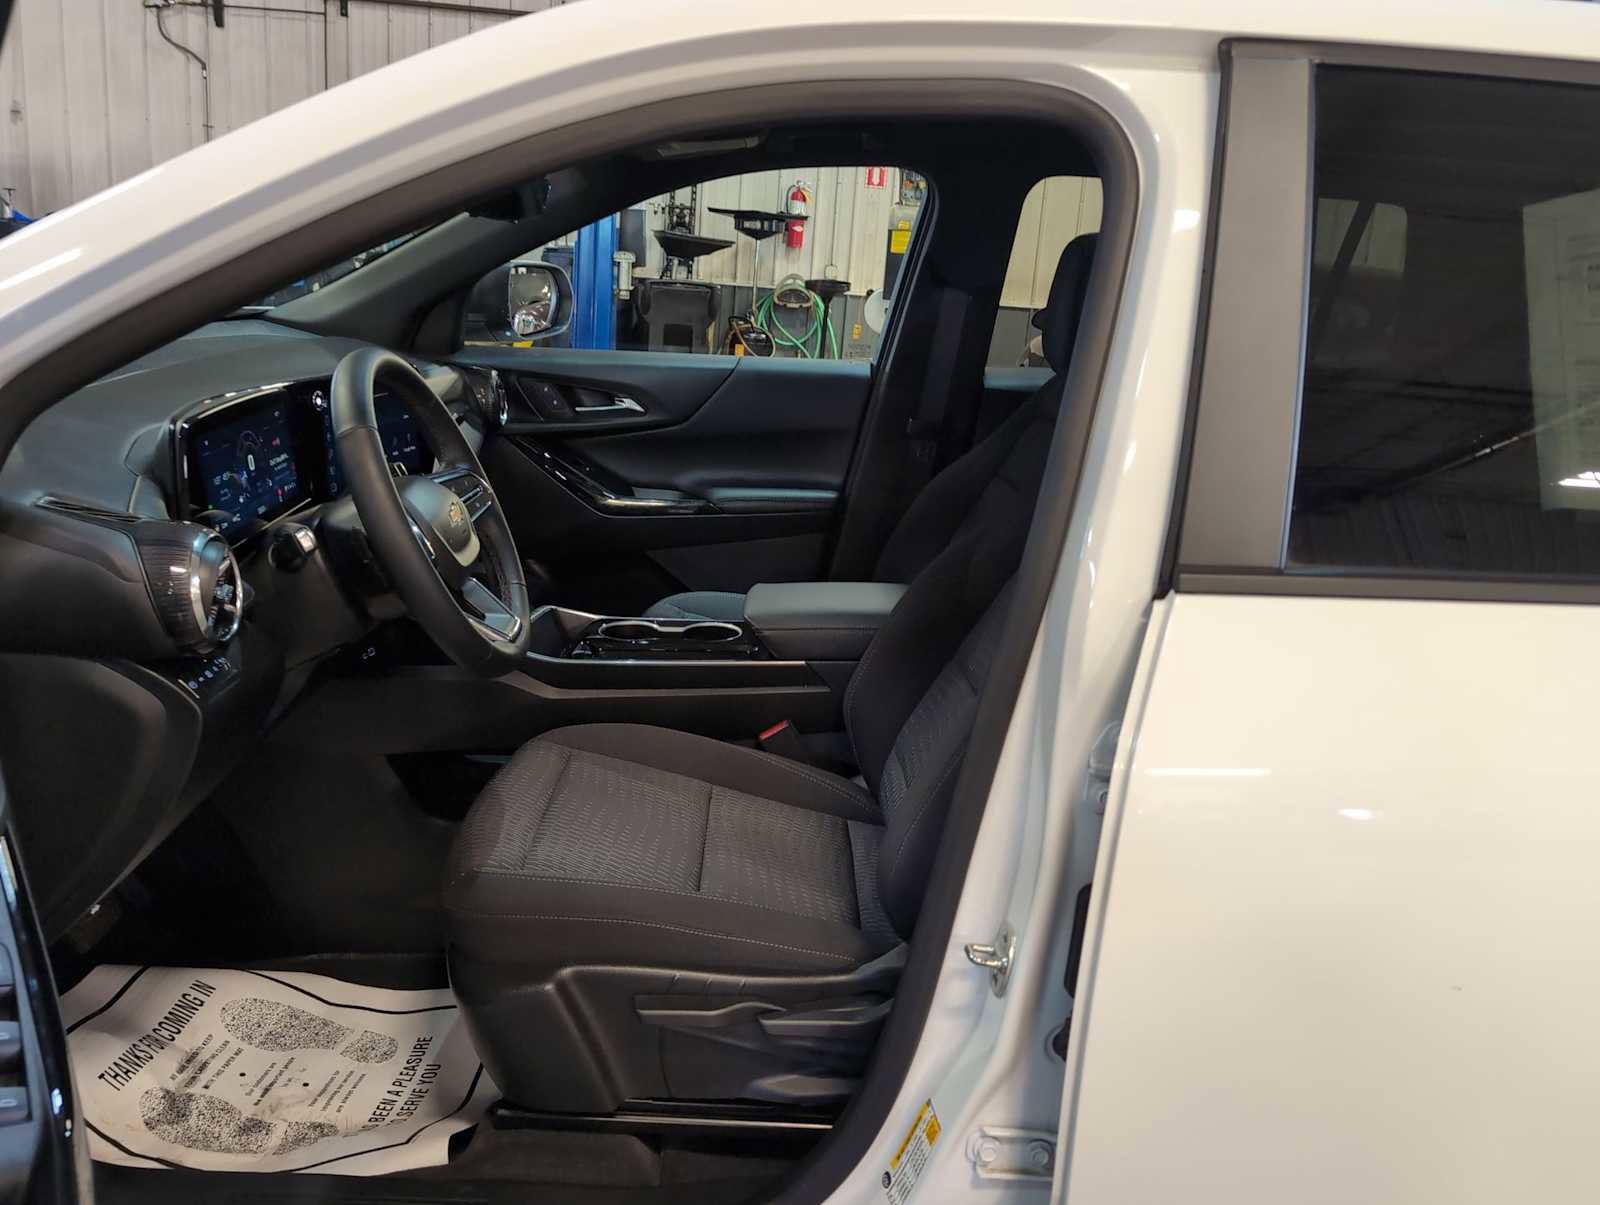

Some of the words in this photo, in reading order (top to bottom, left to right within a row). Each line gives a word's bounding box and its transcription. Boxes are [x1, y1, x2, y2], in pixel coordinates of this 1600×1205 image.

[98, 1043, 153, 1091] THANKS
[152, 993, 205, 1042] COMING
[189, 980, 216, 998] IN
[368, 1098, 398, 1122] BEEN
[392, 1036, 433, 1088] PLEASURE
[396, 1088, 429, 1117] SERVE
[416, 1064, 441, 1086] YOU
